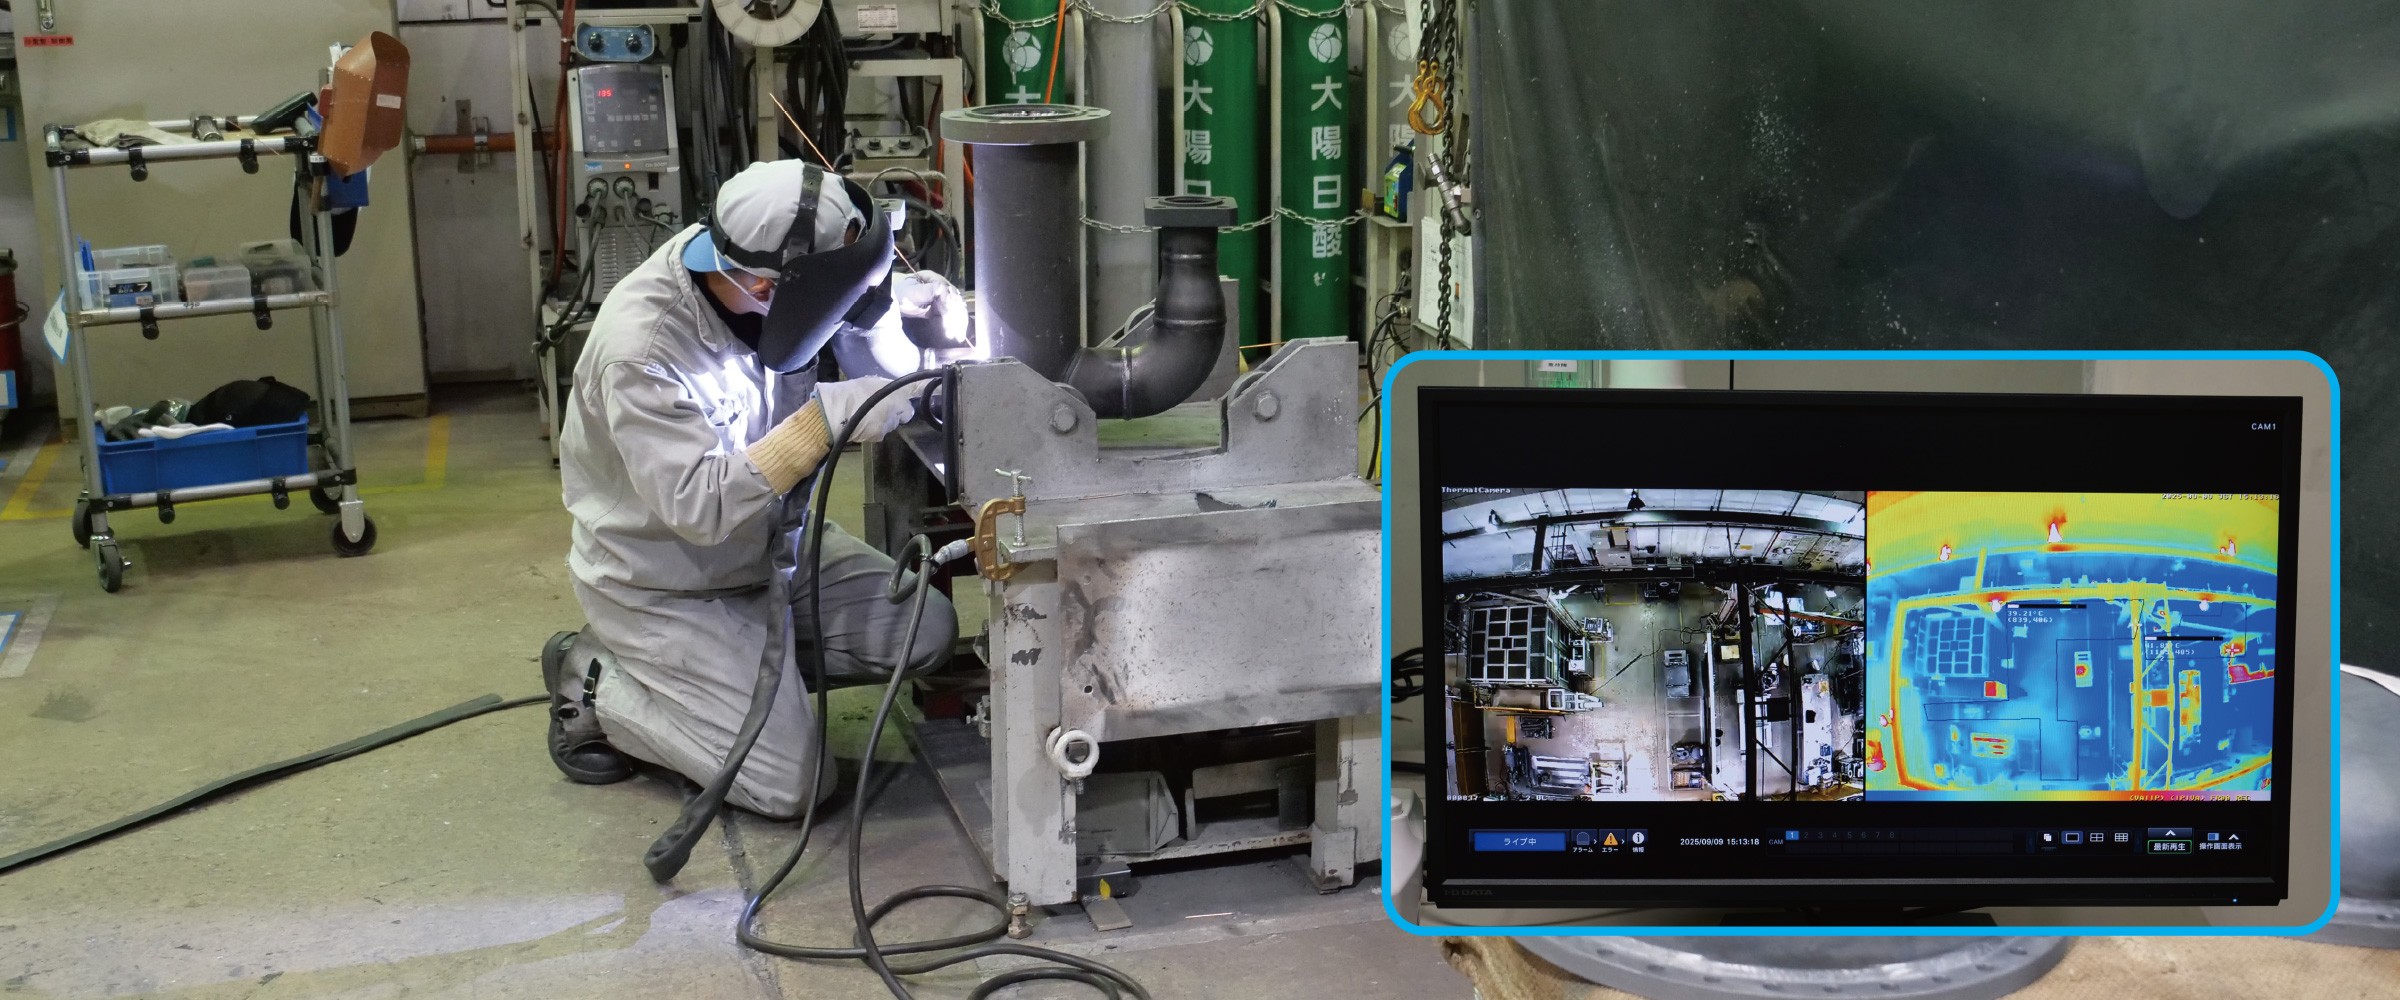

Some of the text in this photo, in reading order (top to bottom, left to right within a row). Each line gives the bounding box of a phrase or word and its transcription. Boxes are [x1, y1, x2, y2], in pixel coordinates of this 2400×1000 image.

[1504, 837, 1537, 846] ライブ中
[1680, 838, 1724, 846] 2025/09/09
[2153, 842, 2186, 851] 最新再生
[2199, 842, 2242, 850] 操作画面表示
